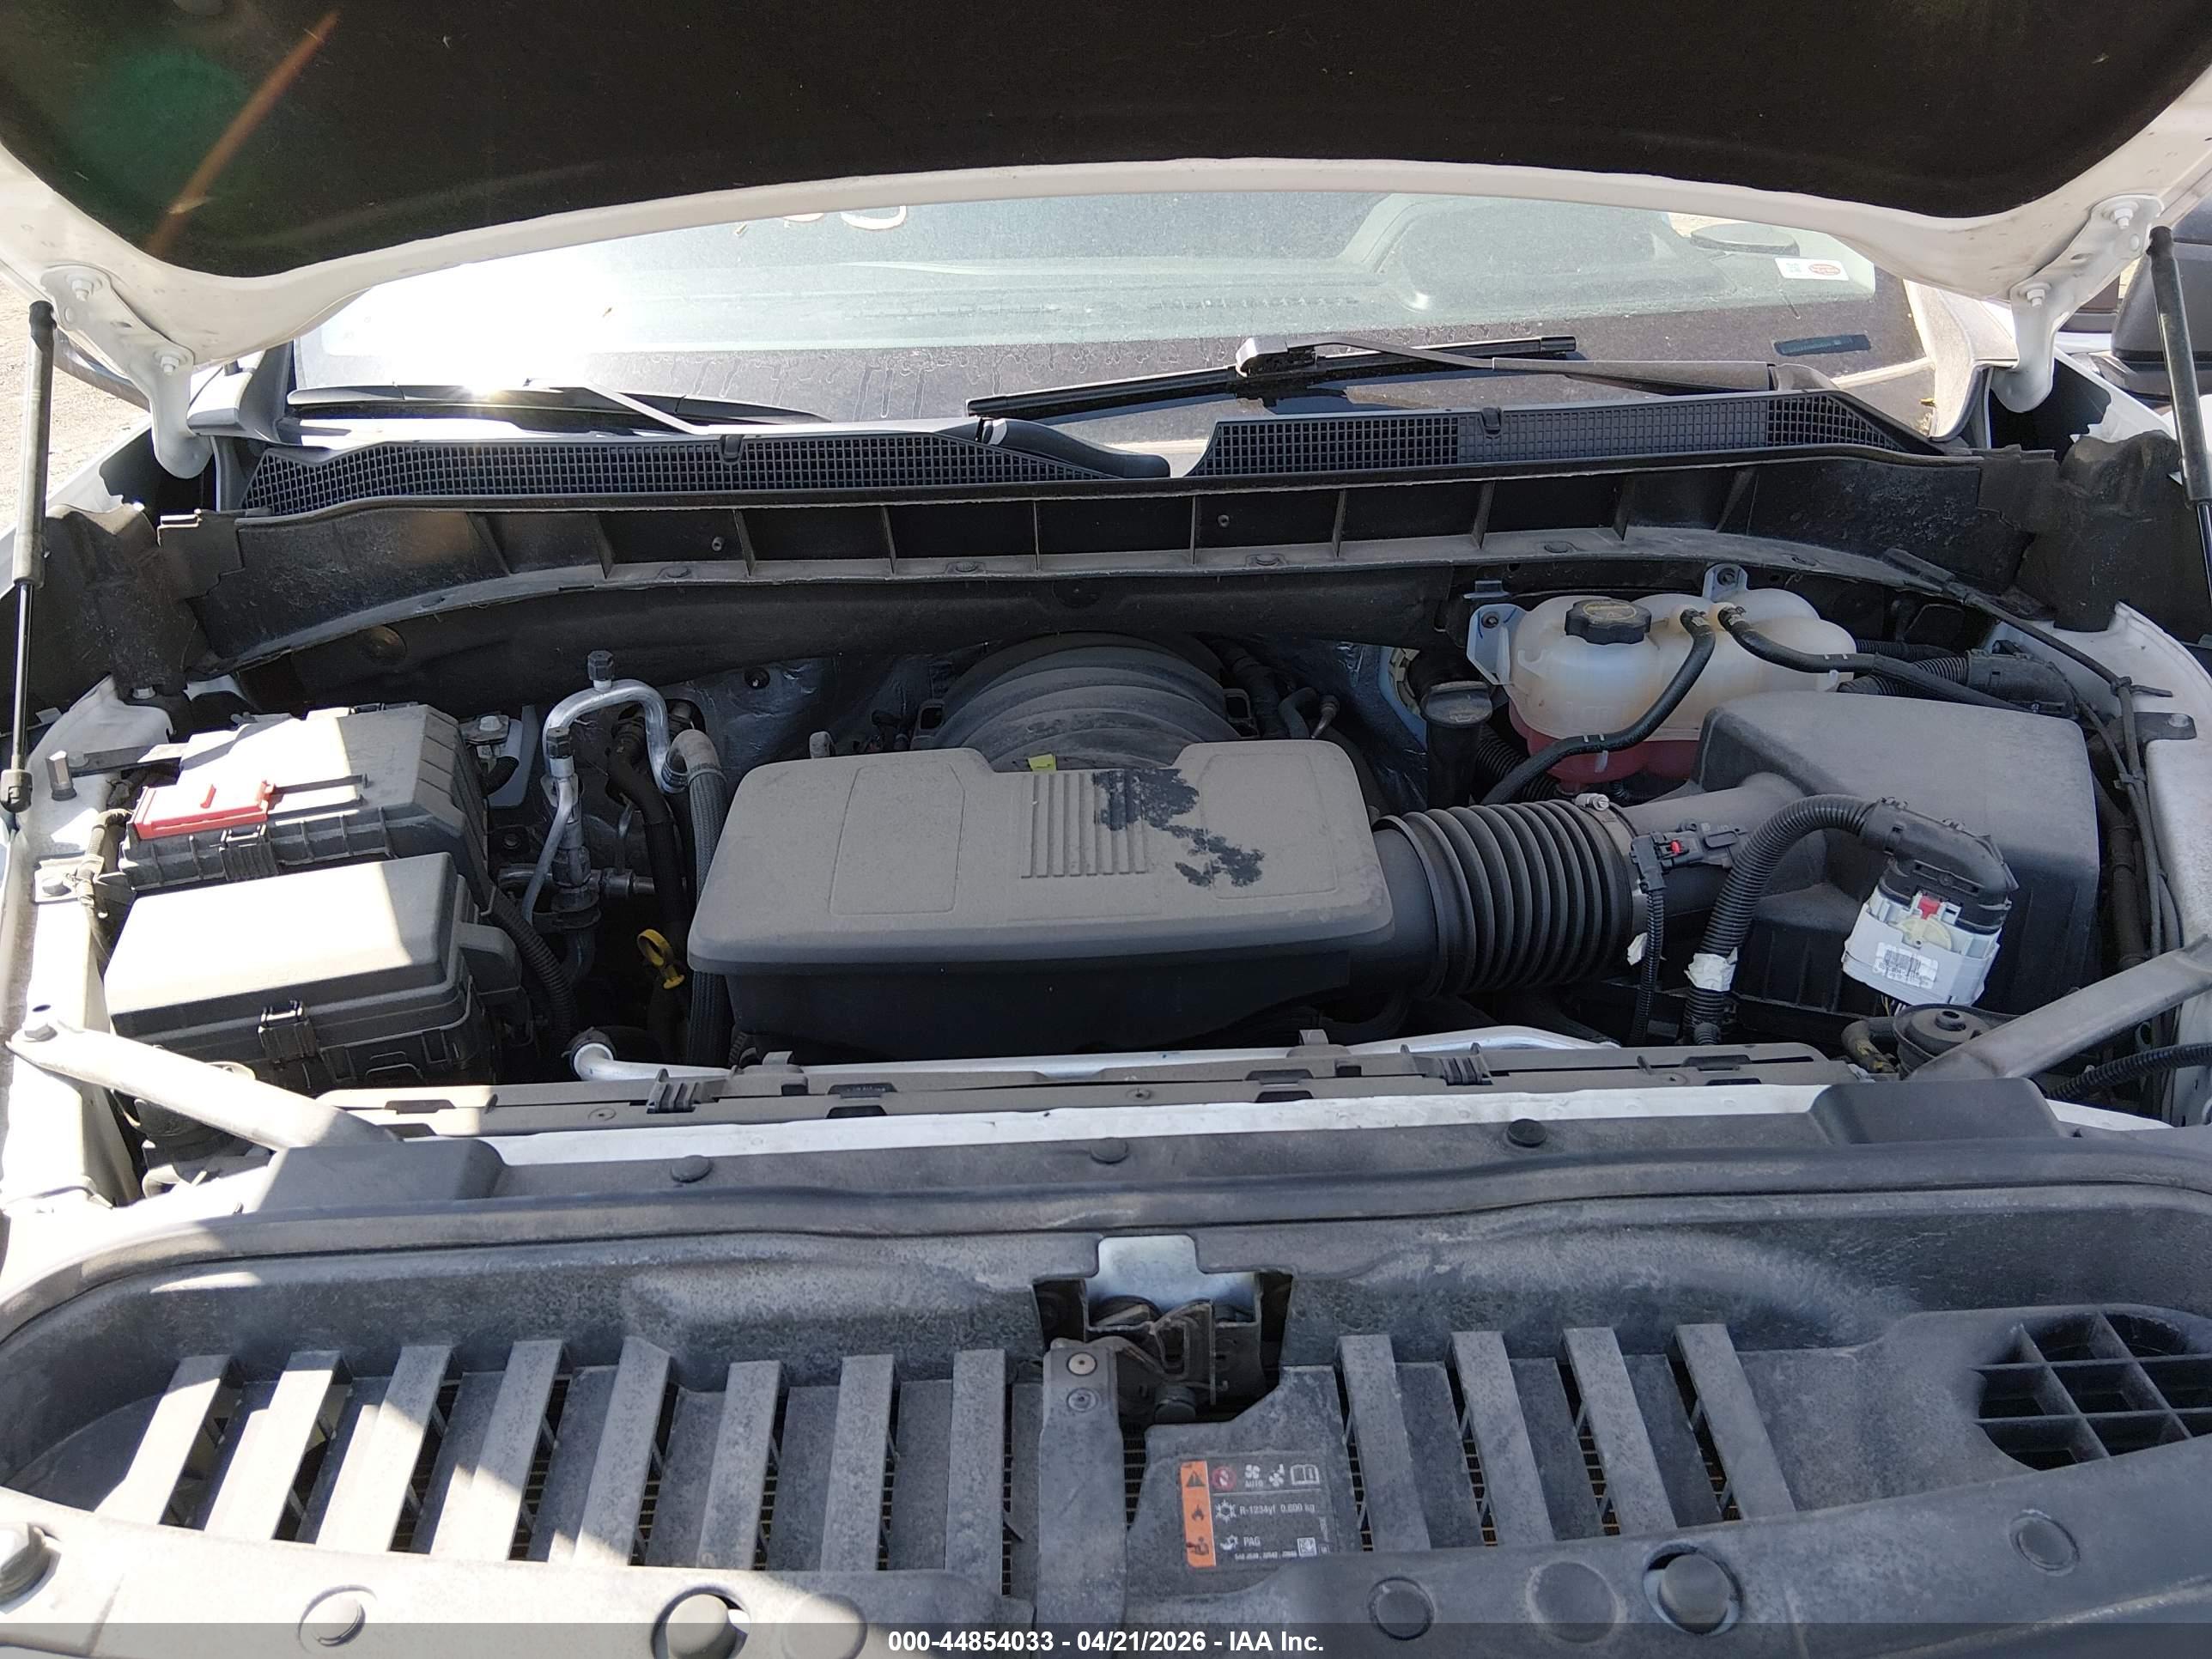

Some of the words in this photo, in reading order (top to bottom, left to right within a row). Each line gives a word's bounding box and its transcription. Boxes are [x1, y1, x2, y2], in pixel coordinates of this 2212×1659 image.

[1239, 1504, 1275, 1516] R-1234yf
[1304, 1503, 1316, 1515] kg
[1243, 1536, 1261, 1547] PAG
